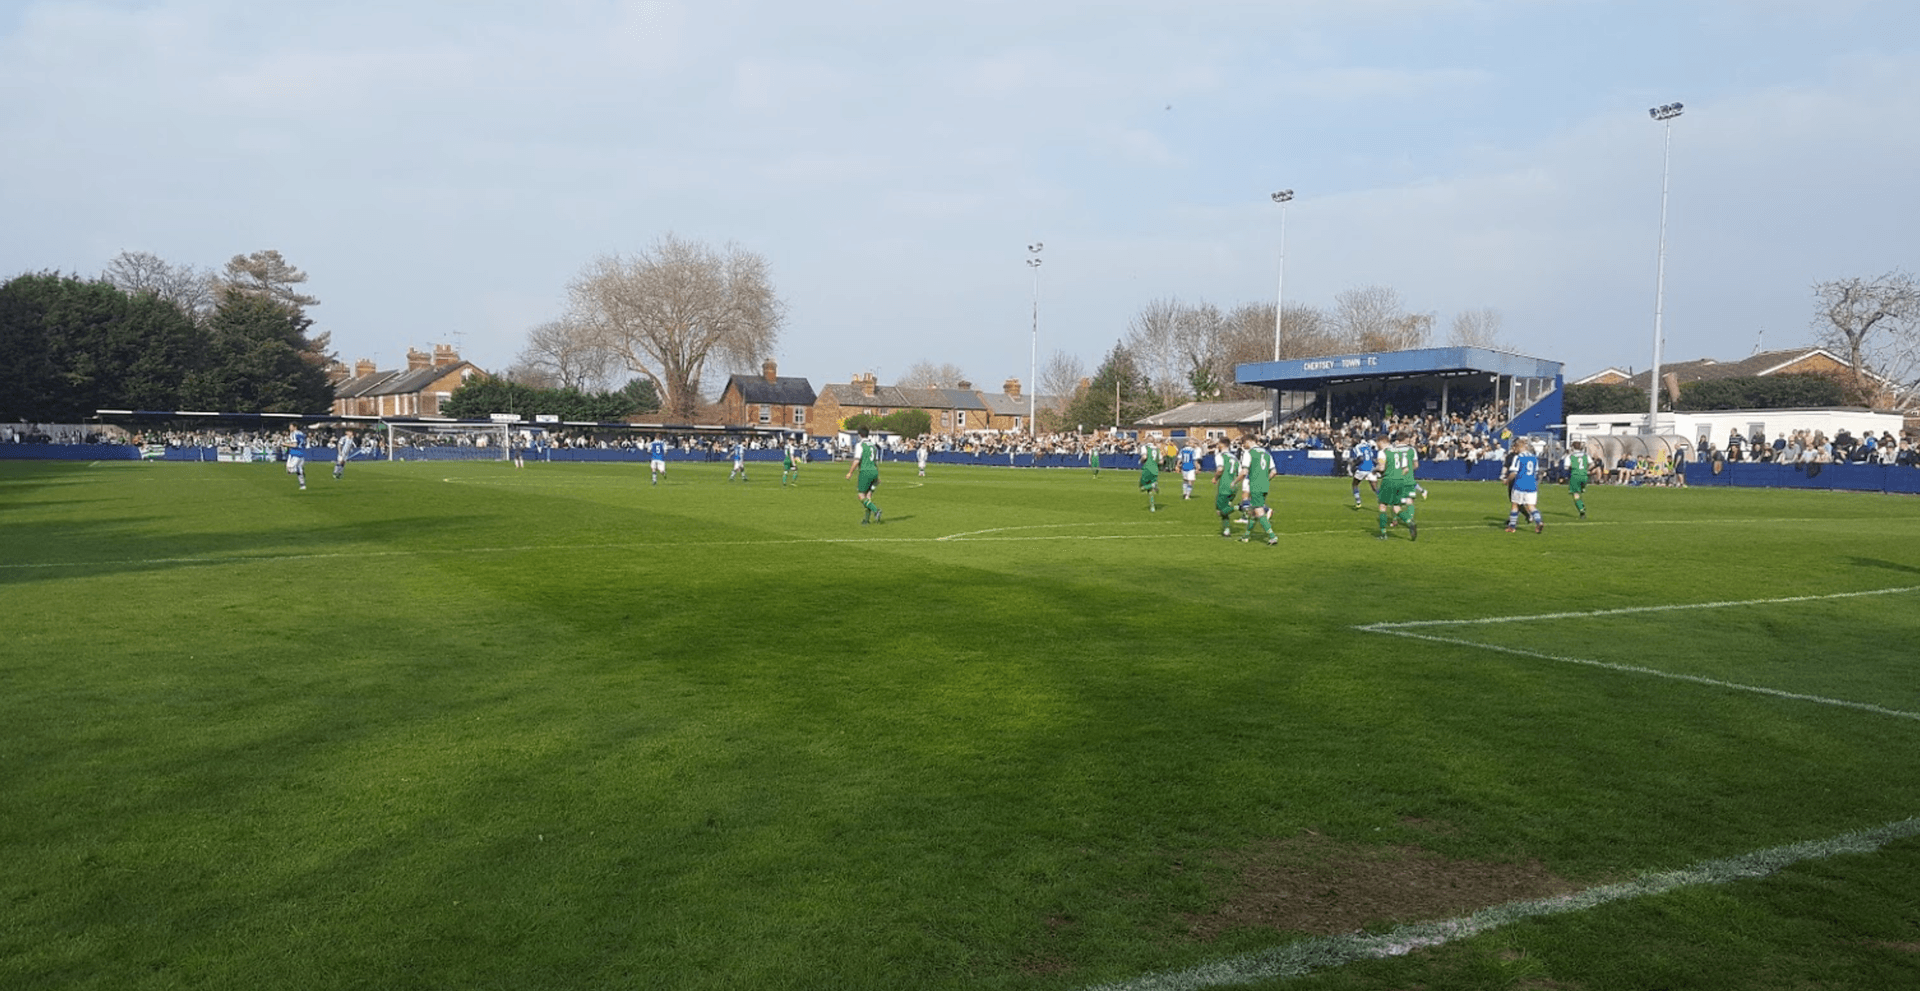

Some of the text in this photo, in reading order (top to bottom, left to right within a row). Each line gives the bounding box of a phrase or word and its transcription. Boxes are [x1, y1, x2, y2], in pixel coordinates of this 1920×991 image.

[1303, 356, 1378, 371] CHERTSEY TOWN FC
[655, 445, 661, 454] 5
[1260, 453, 1267, 470] 6
[1526, 460, 1535, 476] 9
[1578, 457, 1585, 470] 2
